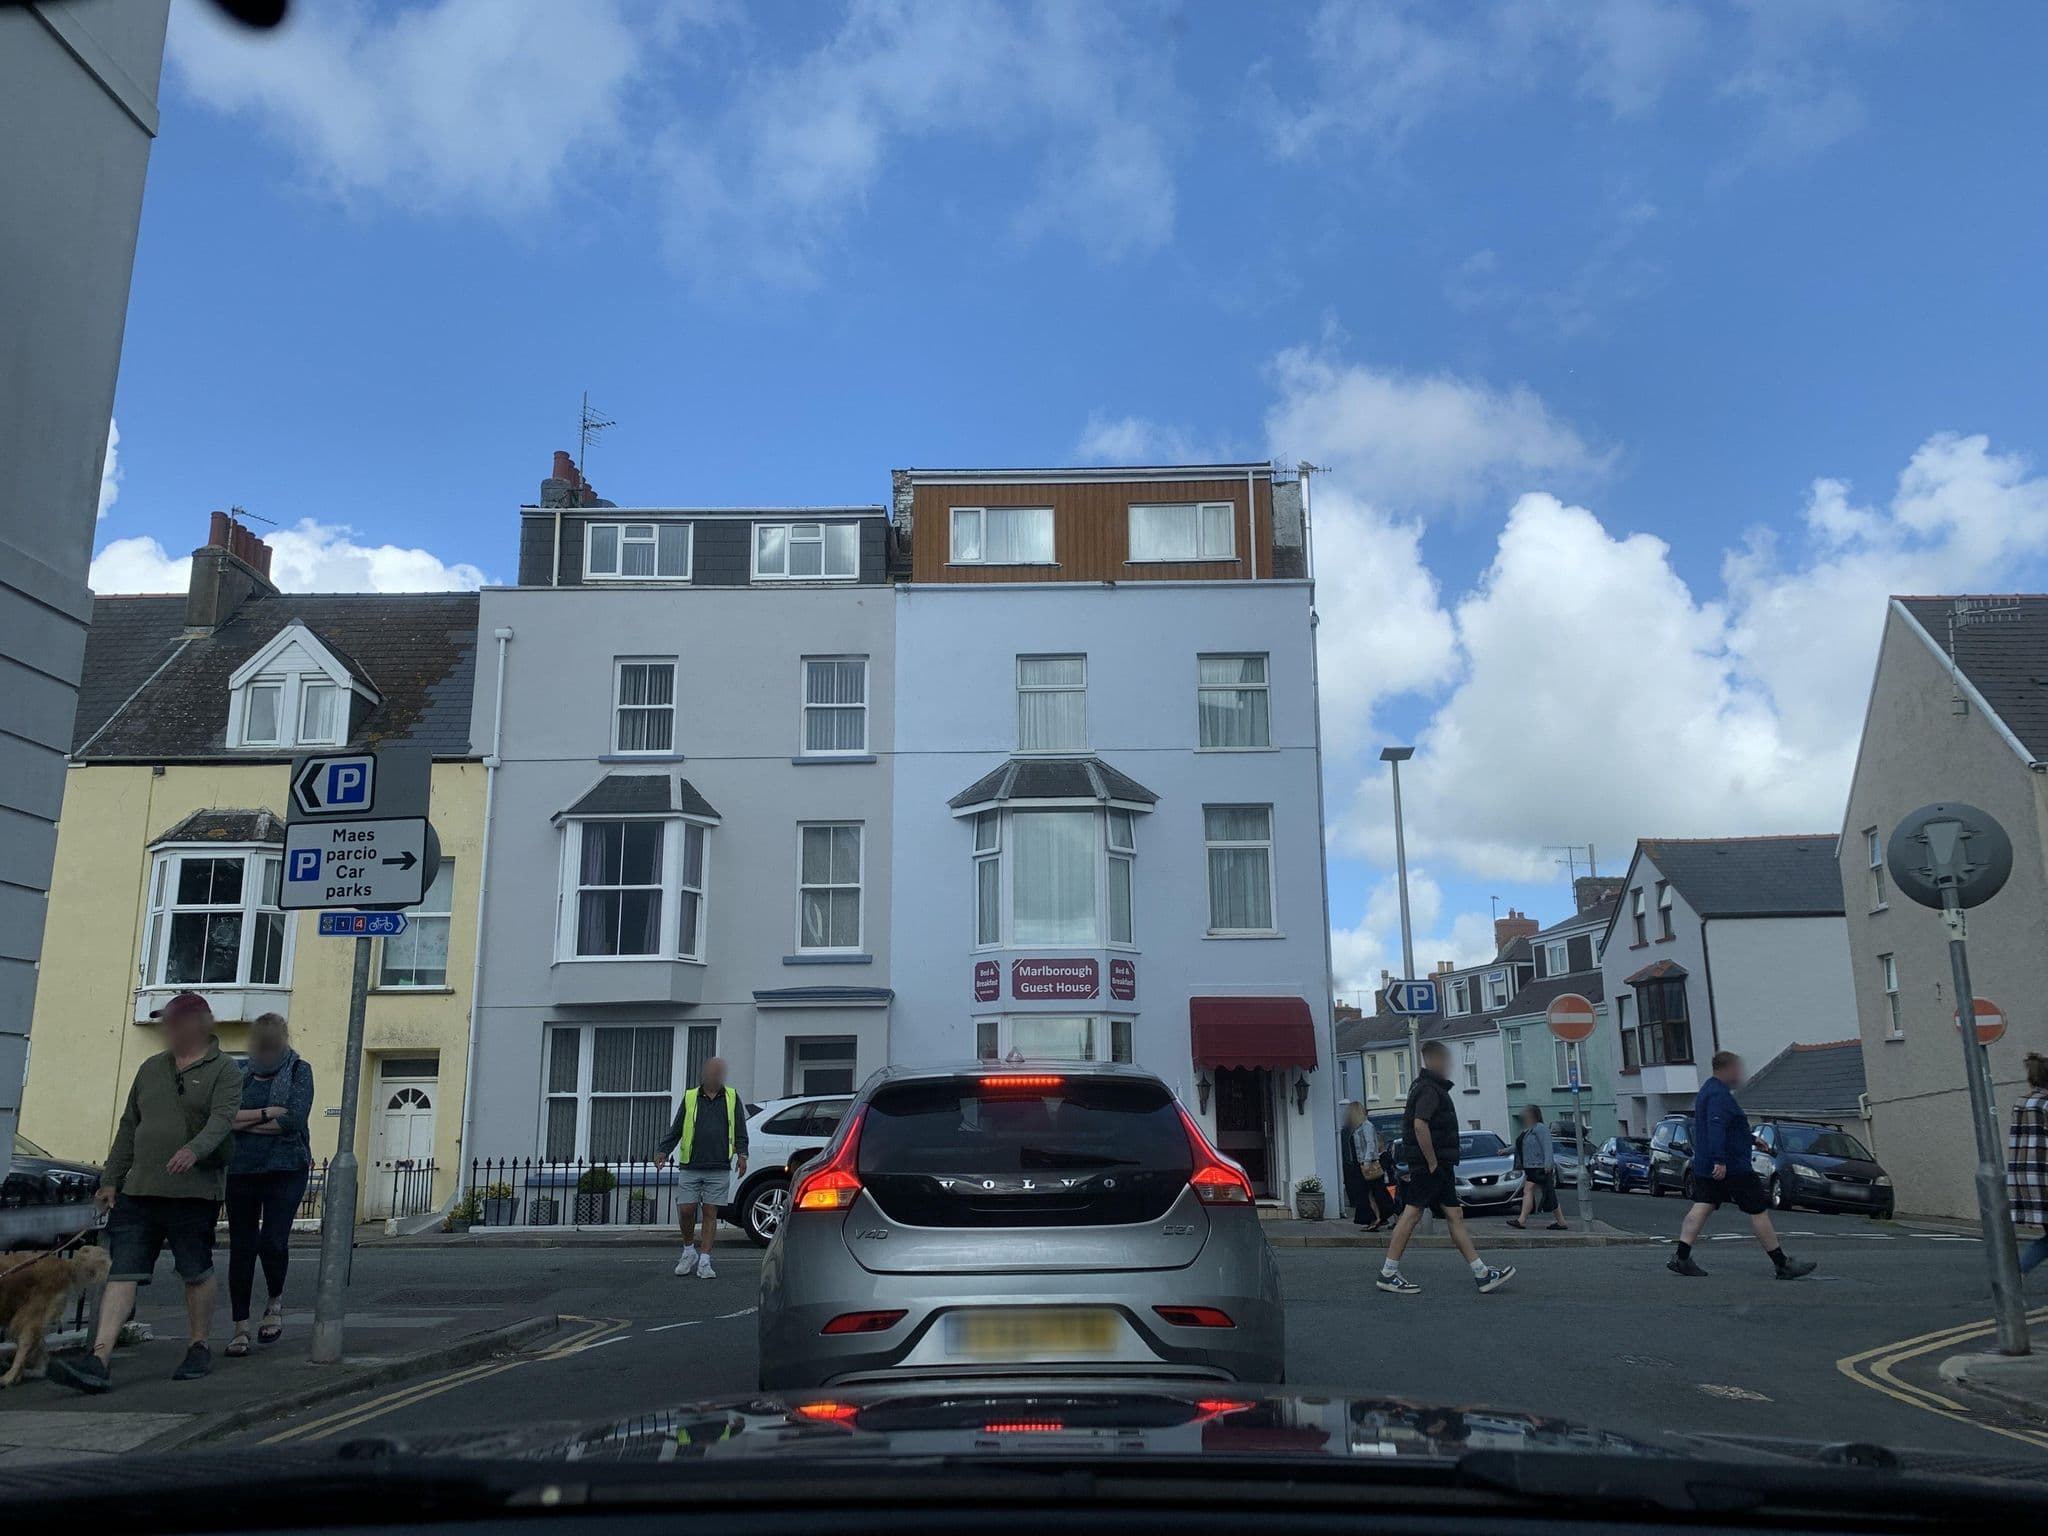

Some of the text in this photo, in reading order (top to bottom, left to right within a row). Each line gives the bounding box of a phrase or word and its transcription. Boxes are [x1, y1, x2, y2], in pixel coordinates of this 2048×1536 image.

[336, 768, 361, 800] P
[332, 829, 375, 842] Maes
[326, 846, 377, 864] parcio
[296, 852, 317, 878] P
[336, 864, 365, 878] Car
[326, 883, 372, 900] parks
[355, 919, 363, 929] 4
[980, 968, 990, 977] Bed
[1019, 966, 1092, 978] Marlborough
[1115, 966, 1125, 975] Bed
[976, 979, 999, 988] Breakfast
[1111, 977, 1134, 986] Breakfast
[1020, 982, 1091, 993] Guest House
[1412, 987, 1430, 1009] P
[938, 1179, 1116, 1190] VOLVO
[855, 1229, 889, 1240] V40
